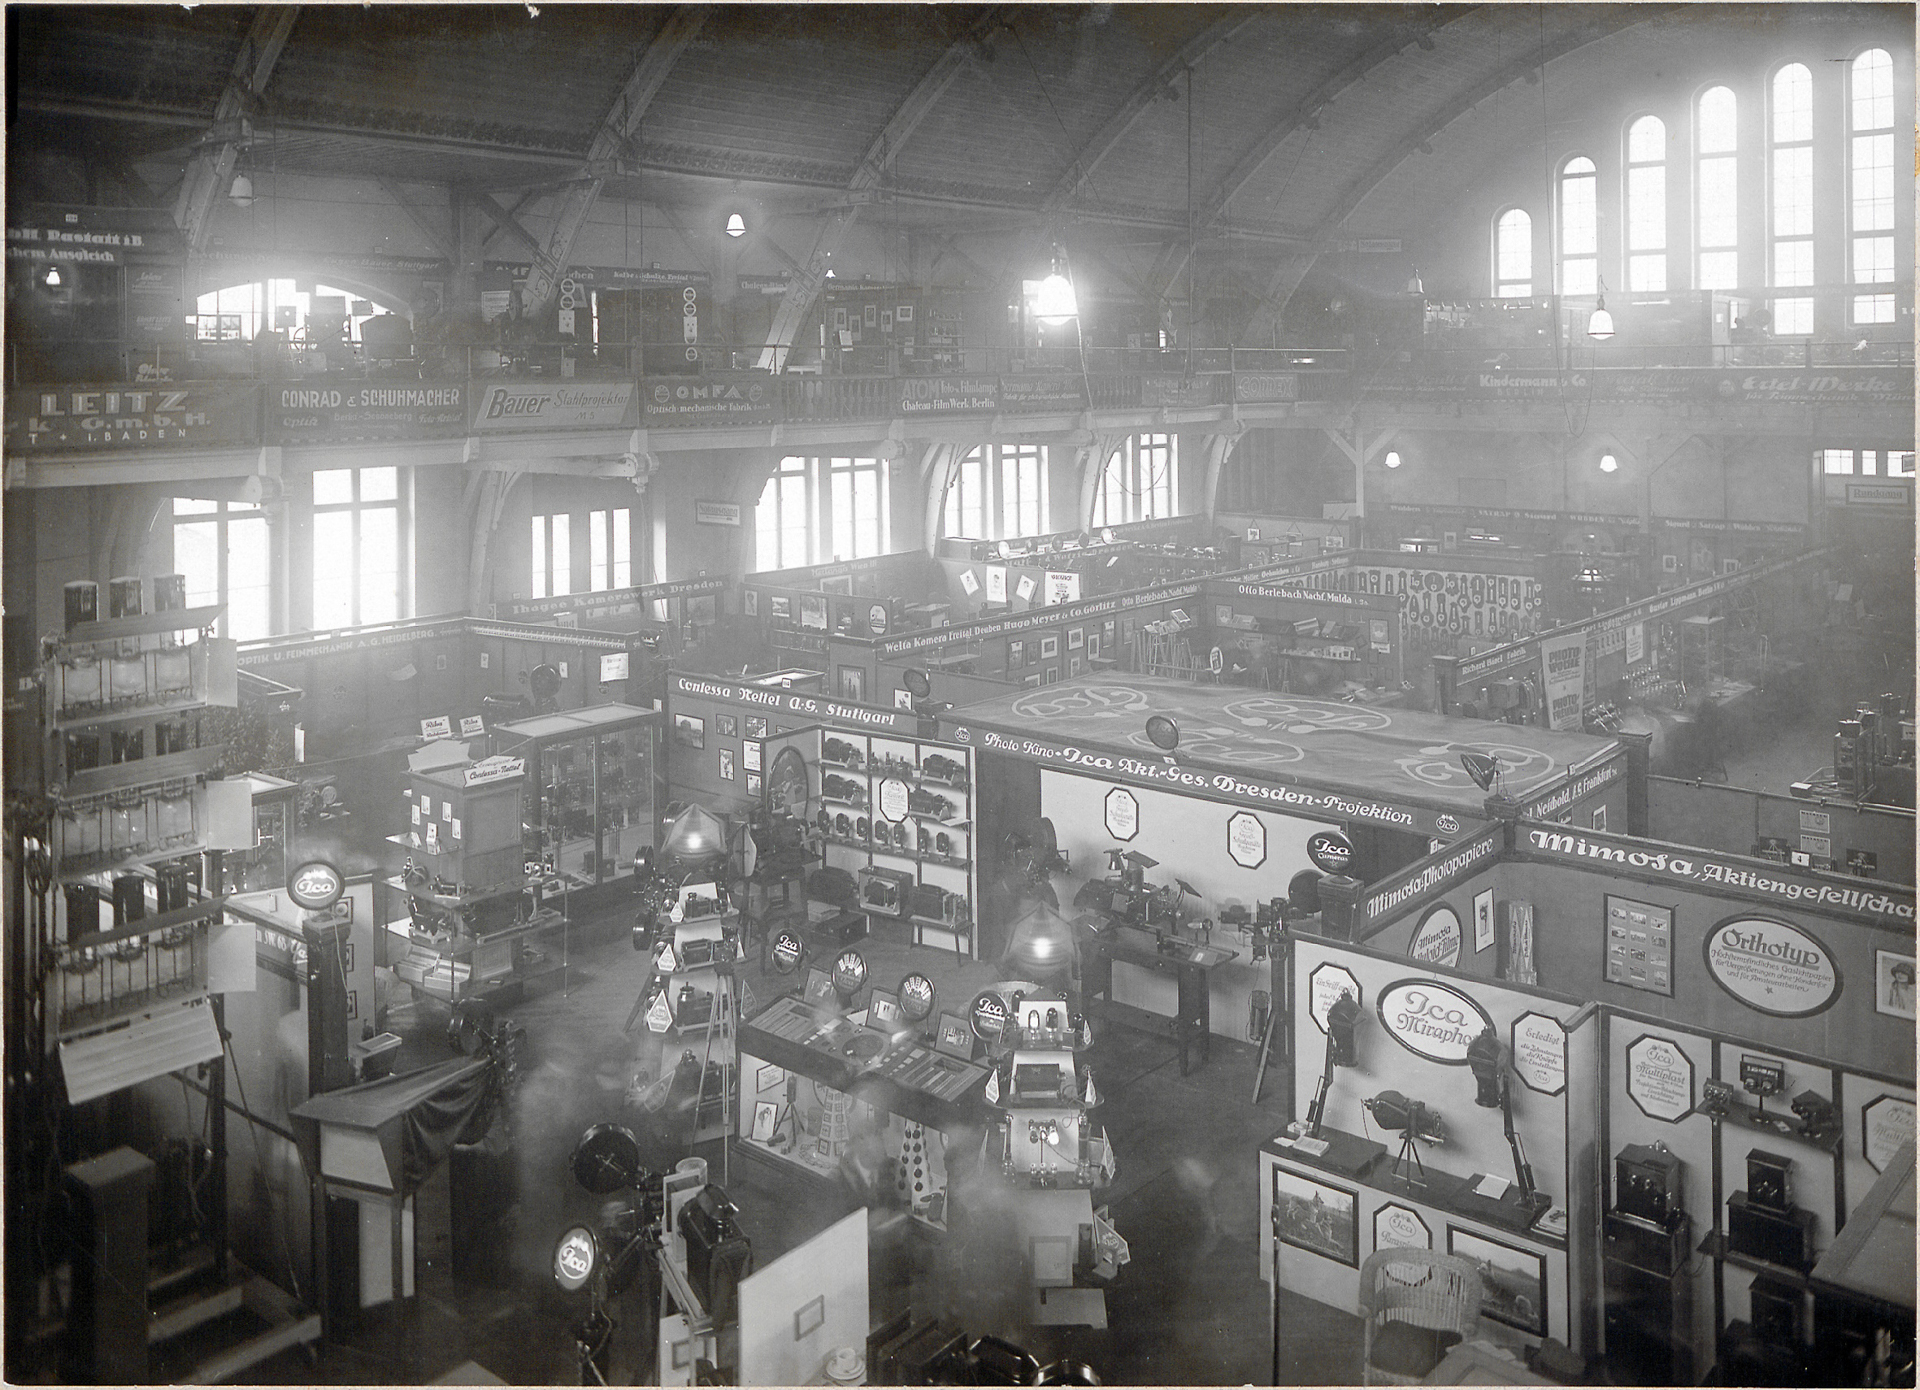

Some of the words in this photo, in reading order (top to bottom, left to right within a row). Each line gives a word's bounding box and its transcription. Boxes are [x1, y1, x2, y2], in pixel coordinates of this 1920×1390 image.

[49, 247, 115, 263] Ausgleich
[397, 260, 439, 271] Stuttgart
[1480, 374, 1558, 387] Kindermann
[281, 390, 341, 408] CONRAD
[347, 396, 357, 407] &
[361, 388, 460, 407] SCHUHMACHER
[676, 385, 744, 400] OMFA
[902, 380, 940, 400] ATOM
[1497, 388, 1544, 396] BERLIN
[40, 390, 188, 416] LEITZ
[485, 386, 551, 419] Bauer
[553, 389, 629, 408] Stahlprojektor
[729, 402, 752, 411] Fabrik
[972, 397, 995, 409] Berlin
[105, 428, 187, 442] BADEN
[512, 599, 567, 615] Ihagee
[573, 587, 665, 611] Kamerawerk
[670, 579, 724, 594] Dresden
[1238, 584, 1257, 595] Otto
[1258, 586, 1302, 599] Berlebach
[1303, 589, 1326, 601] Nachf.
[1327, 592, 1352, 604] Mulda
[884, 639, 912, 654] Welta
[914, 631, 947, 651] Kamera
[975, 621, 1001, 639] Deuben
[1003, 617, 1030, 632] Hugo
[1032, 611, 1061, 628] Meyer
[237, 654, 269, 667] OPTIK
[285, 641, 354, 660] FEINMECHANIK
[1548, 646, 1580, 663] PHOTO
[1548, 657, 1580, 674] WOCHE
[678, 677, 731, 699] Contessa
[738, 686, 780, 707] Nettel
[826, 702, 896, 727] Stuttgart
[984, 732, 1019, 752] Photo
[1314, 838, 1351, 856] Ica
[1317, 852, 1349, 862] Cameras
[298, 880, 333, 895] Ica
[277, 935, 287, 951] 68
[779, 934, 798, 951] Ica
[1721, 928, 1820, 967] Orthotyp
[1727, 969, 1739, 978] und
[1750, 974, 1810, 993] Amateurarbeiten
[978, 997, 1004, 1016] Ica
[1404, 990, 1468, 1027] Ica
[1396, 1012, 1474, 1048] Mirapho
[1525, 1027, 1560, 1045] Erledigt
[1649, 1050, 1672, 1064] Ica
[1635, 1064, 1686, 1085] Multiplast
[1392, 1217, 1414, 1234] Ica
[560, 1247, 588, 1273] Ica
